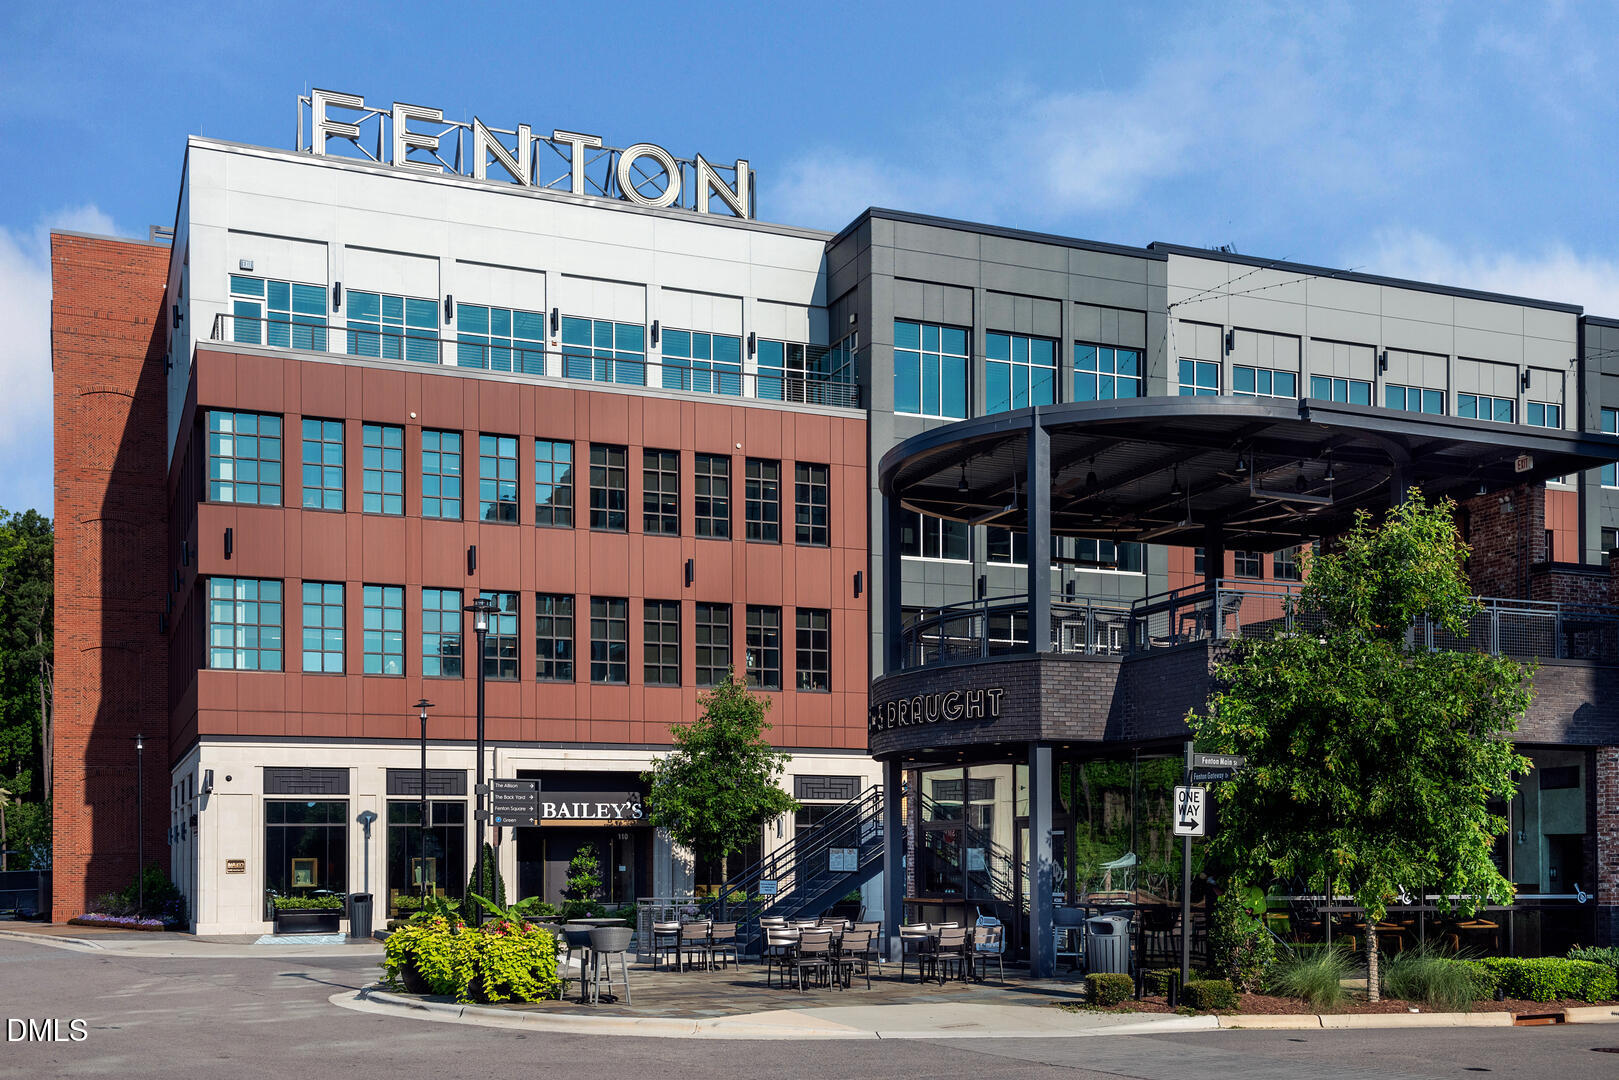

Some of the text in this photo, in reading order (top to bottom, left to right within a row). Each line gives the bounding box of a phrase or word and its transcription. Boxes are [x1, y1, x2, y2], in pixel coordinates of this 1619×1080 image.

[311, 87, 749, 220] FENTON
[1517, 457, 1529, 470] EXIT
[886, 688, 1004, 729] DRAUGHT
[1201, 756, 1219, 765] Fenton
[1220, 757, 1233, 766] Main
[1193, 772, 1207, 780] Fenton
[1207, 771, 1224, 780] Gateway
[1178, 790, 1200, 803] ONE
[541, 801, 643, 819] BAILEY'S
[1178, 804, 1200, 817] WAY
